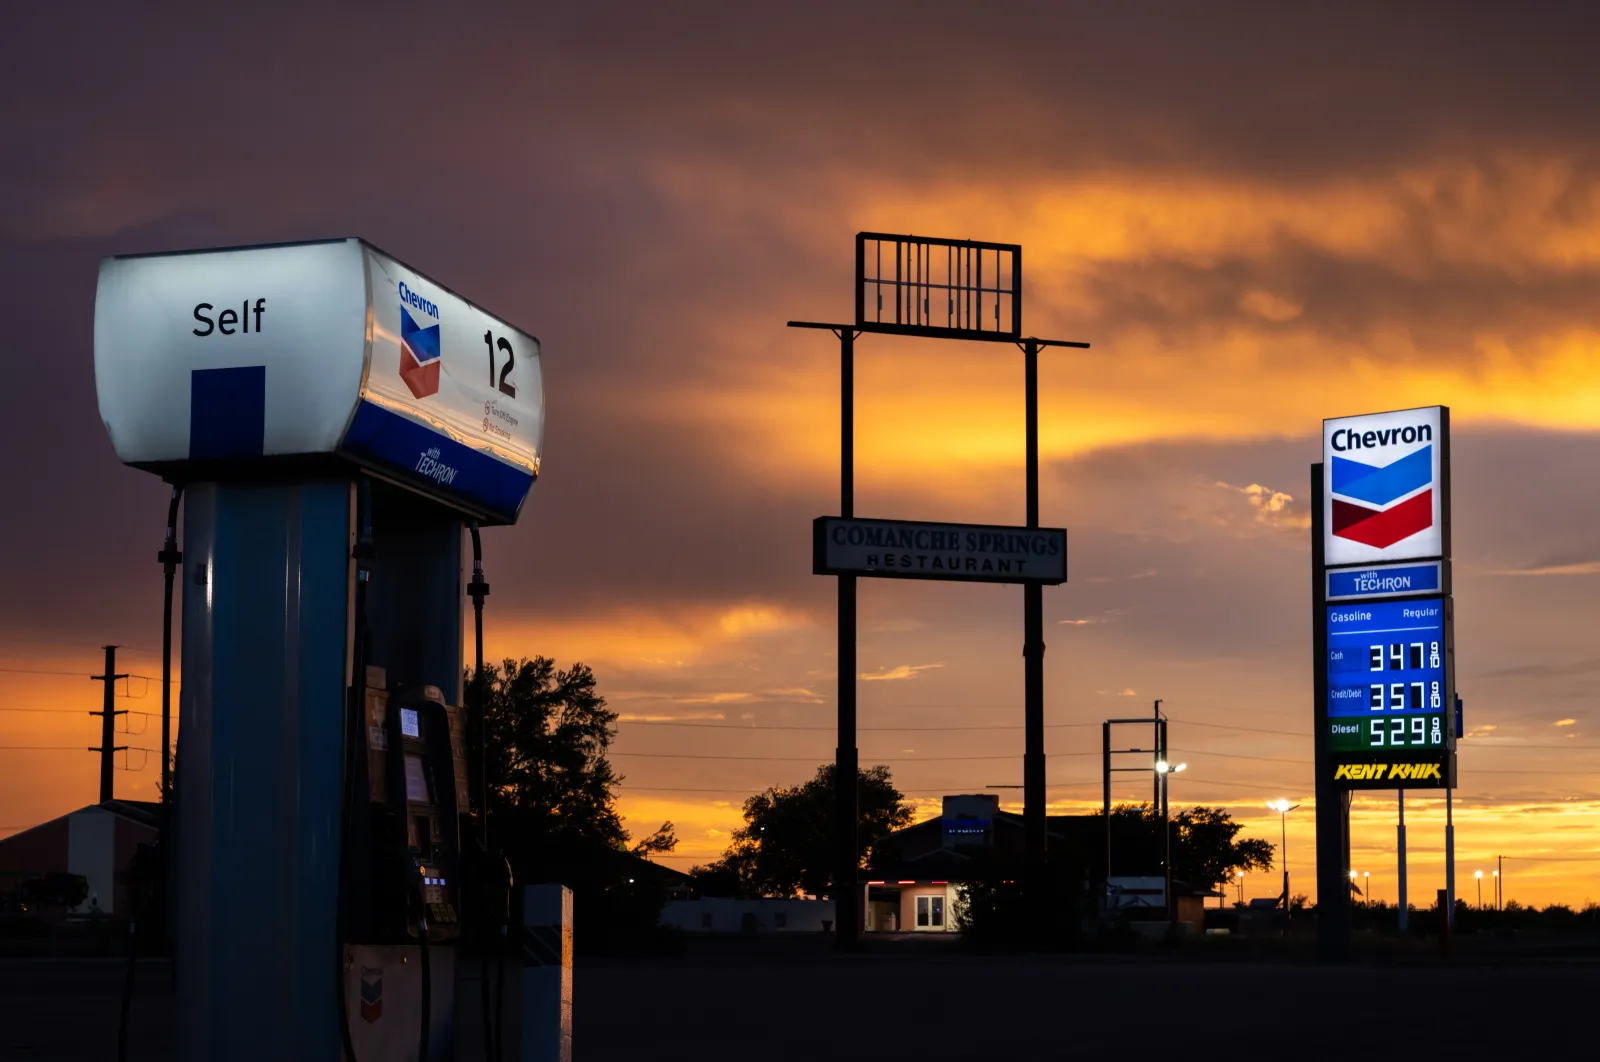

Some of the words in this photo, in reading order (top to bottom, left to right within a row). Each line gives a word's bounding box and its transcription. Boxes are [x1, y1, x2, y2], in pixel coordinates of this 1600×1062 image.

[399, 281, 440, 320] Chevron
[192, 297, 266, 337] Self
[484, 329, 516, 399] 12
[1331, 424, 1432, 452] Chevron
[427, 447, 441, 461] with
[414, 451, 458, 485] TECHRON
[832, 525, 960, 551] COMANCHE
[965, 530, 1059, 556] SPRINGS
[1360, 570, 1378, 580] with
[1354, 576, 1411, 591] TECHRON
[1331, 611, 1372, 622] Gasoline
[1403, 608, 1439, 619] Regular
[1330, 651, 1344, 660] Cash
[1331, 689, 1362, 699] Credit/Debit
[1331, 724, 1359, 733] Diesel
[1334, 764, 1388, 780] KENT
[1388, 763, 1441, 779] KWIK
